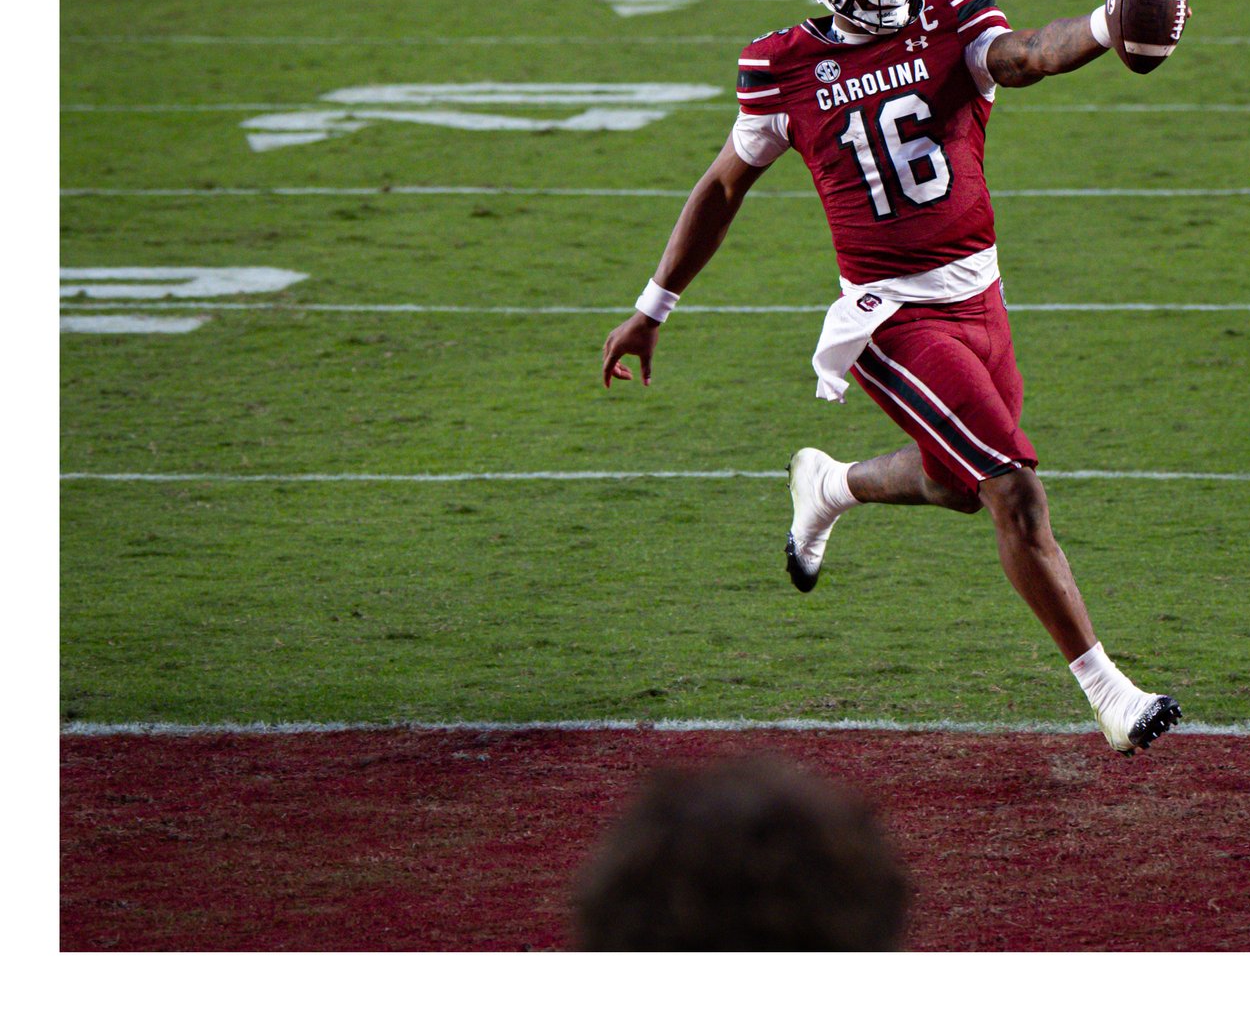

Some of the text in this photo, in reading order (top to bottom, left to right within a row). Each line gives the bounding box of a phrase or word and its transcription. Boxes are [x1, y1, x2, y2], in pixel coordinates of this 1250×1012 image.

[919, 0, 939, 31] C
[816, 58, 929, 110] CAROLINA
[817, 62, 839, 82] SEC
[839, 91, 953, 219] 16
